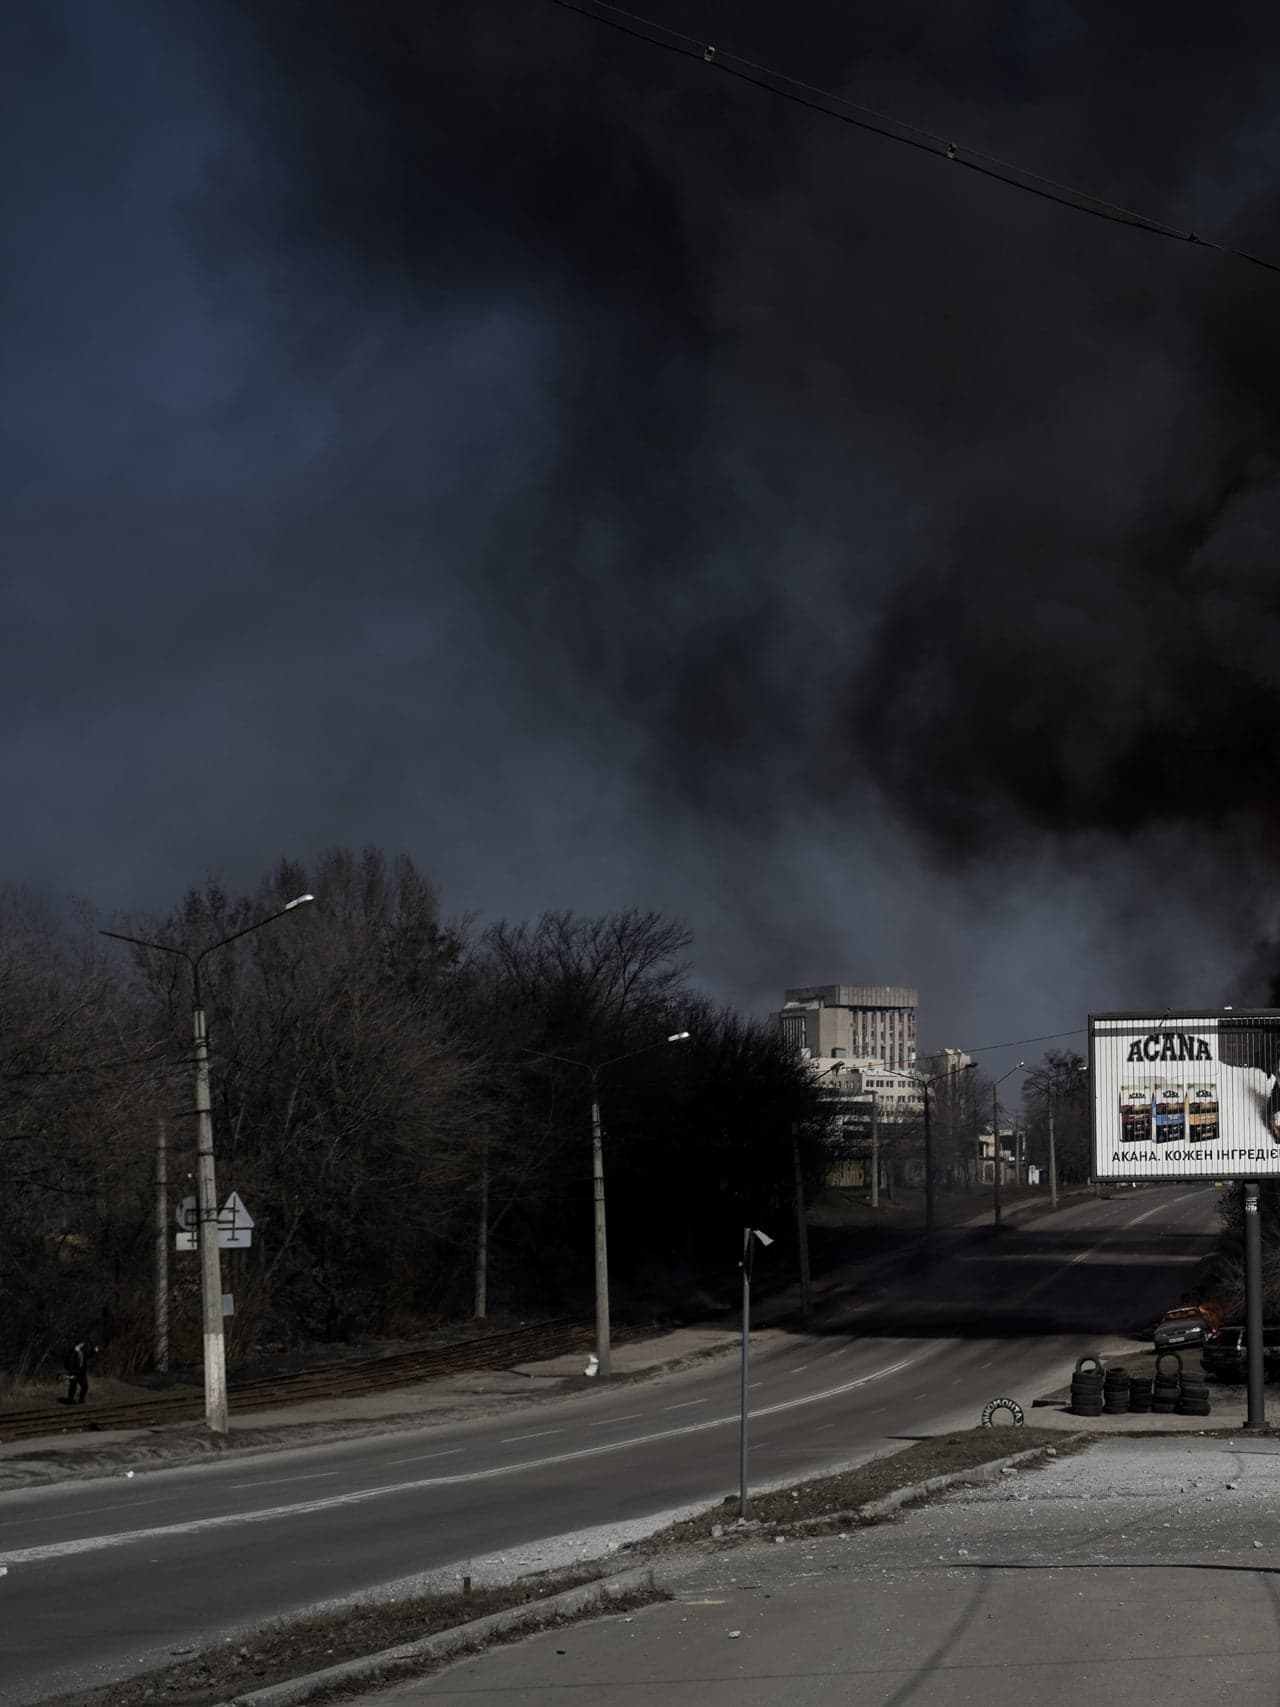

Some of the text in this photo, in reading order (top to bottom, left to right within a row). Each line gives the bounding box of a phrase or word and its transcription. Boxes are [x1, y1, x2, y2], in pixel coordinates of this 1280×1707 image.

[1127, 1033, 1213, 1062] ACANA
[1112, 1151, 1161, 1162] АКАНА.
[1165, 1150, 1213, 1161] КОЖЕН
